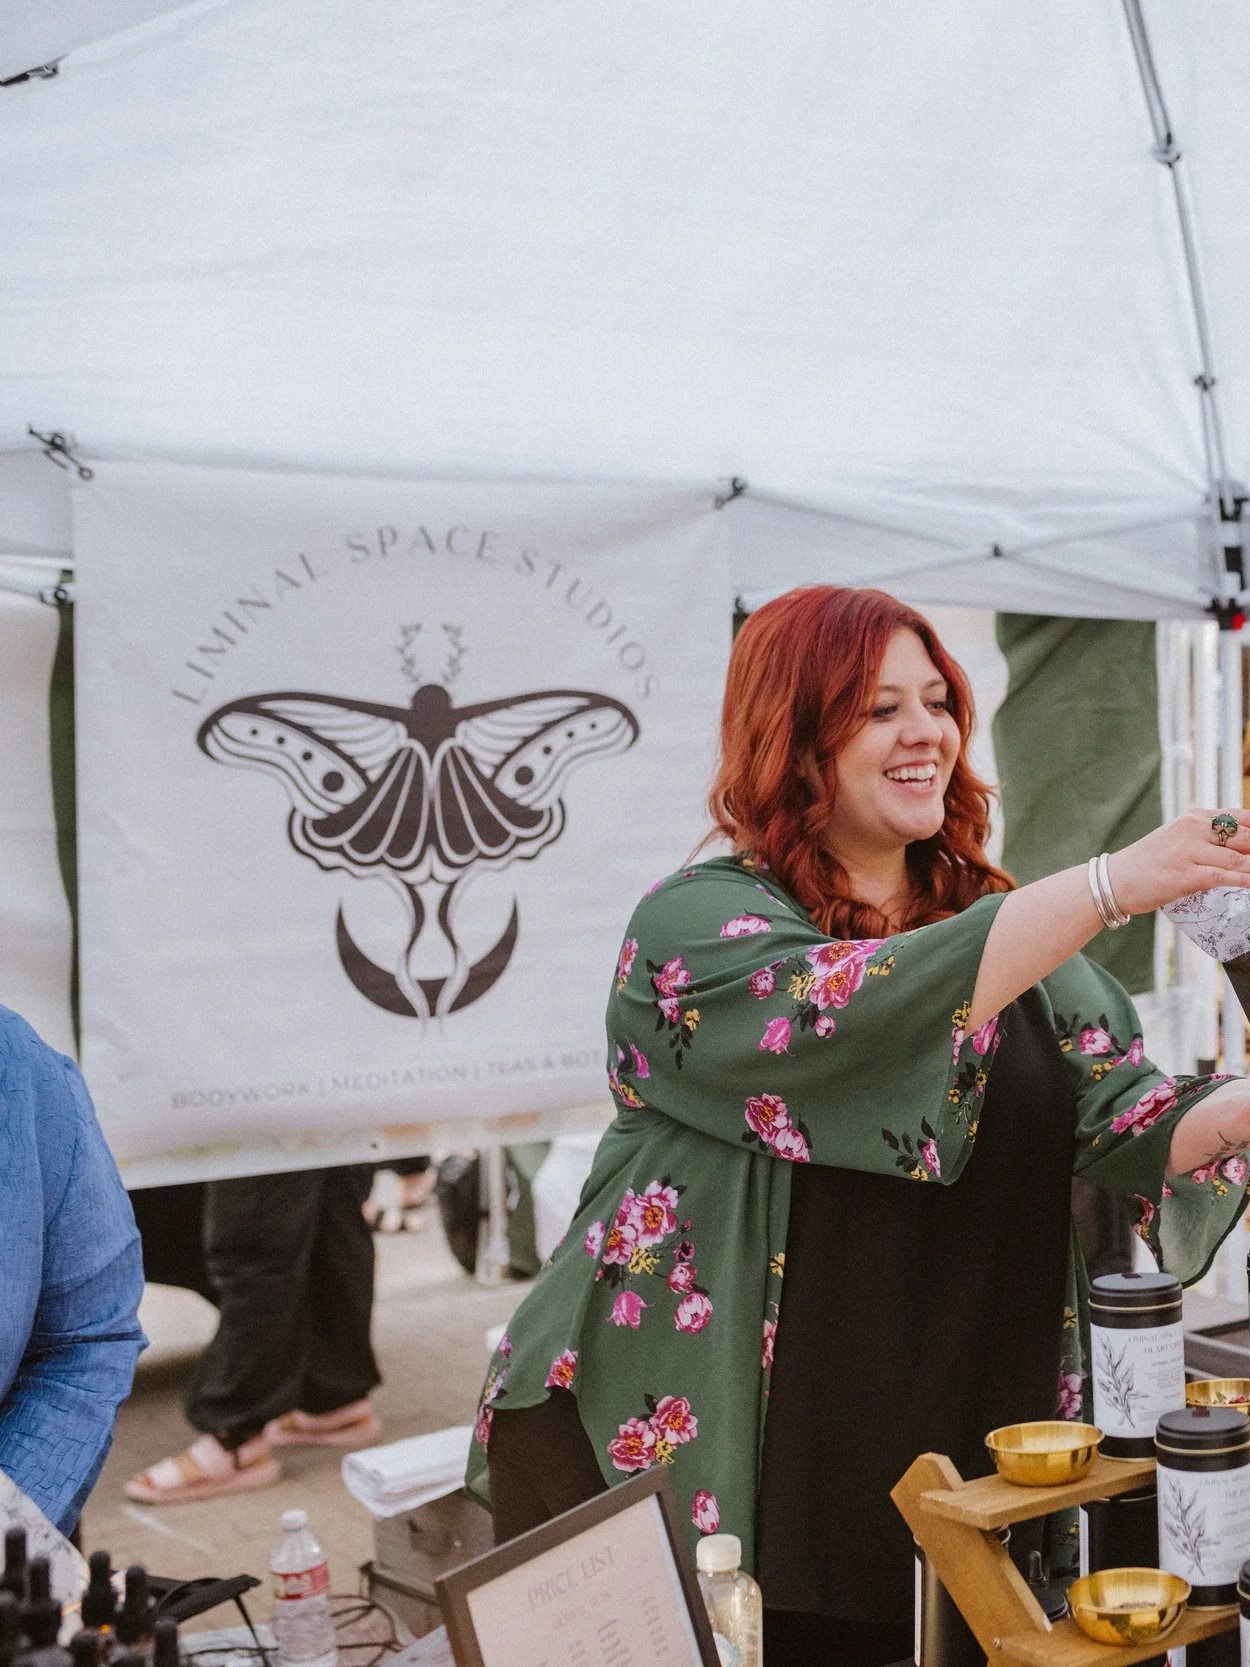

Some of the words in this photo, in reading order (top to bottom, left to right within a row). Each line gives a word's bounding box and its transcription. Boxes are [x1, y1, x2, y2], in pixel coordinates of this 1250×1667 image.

[171, 551, 330, 705] LIMINAL
[346, 524, 496, 565] SPACE
[513, 549, 659, 699] STUDIOS
[171, 1082, 311, 1110] BODYWORK
[331, 1063, 467, 1093] MEDITATION
[527, 1565, 578, 1611] PRICE
[580, 1546, 615, 1581] LIST
